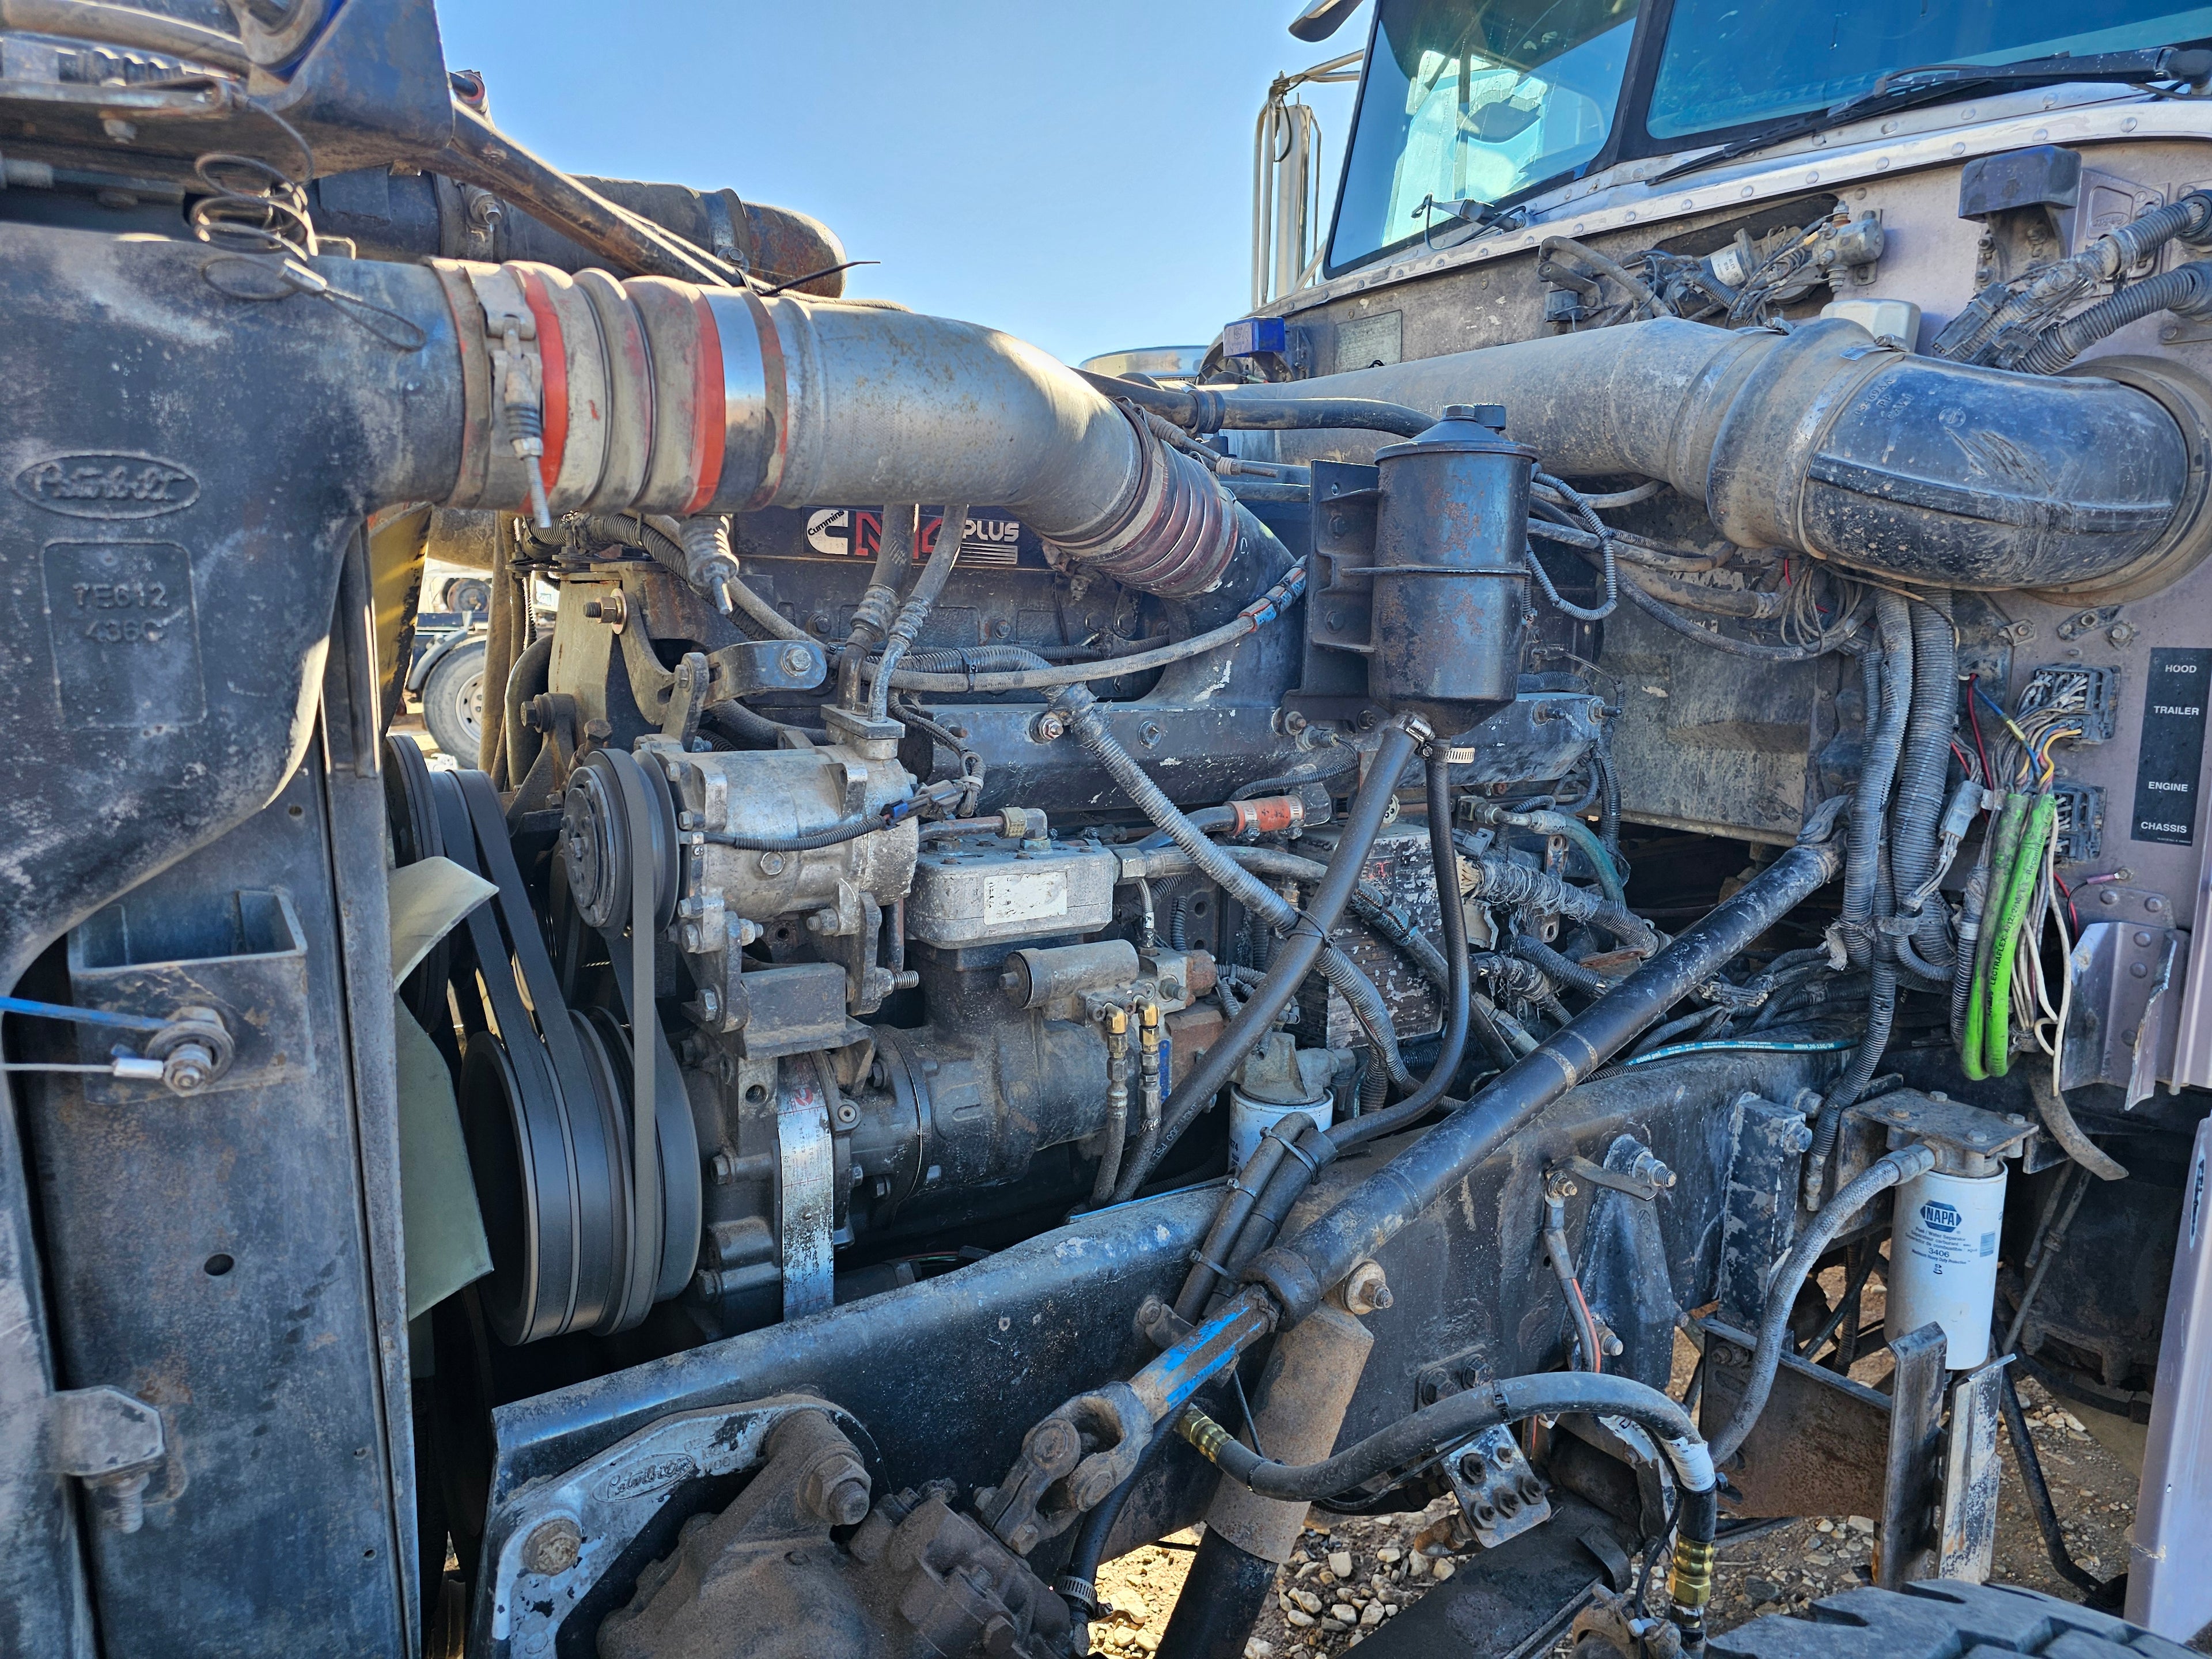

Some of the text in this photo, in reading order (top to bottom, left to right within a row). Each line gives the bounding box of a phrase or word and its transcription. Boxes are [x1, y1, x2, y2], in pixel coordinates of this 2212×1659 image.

[1878, 395, 1891, 407] PP
[807, 510, 845, 536] Cummins
[962, 520, 1020, 543] PLUS
[2165, 664, 2197, 673] HOOD
[2154, 706, 2199, 715] TRAILER
[2148, 781, 2188, 792] ENGINE
[2141, 821, 2187, 834] CHASSIS
[1650, 1050, 1661, 1059] psi
[1166, 1126, 1180, 1142] 300
[1152, 1143, 1168, 1160] PSI
[1926, 1207, 1955, 1226] NAPA
[1928, 1248, 1950, 1257] 3406
[607, 1456, 689, 1499] Peterbilt
